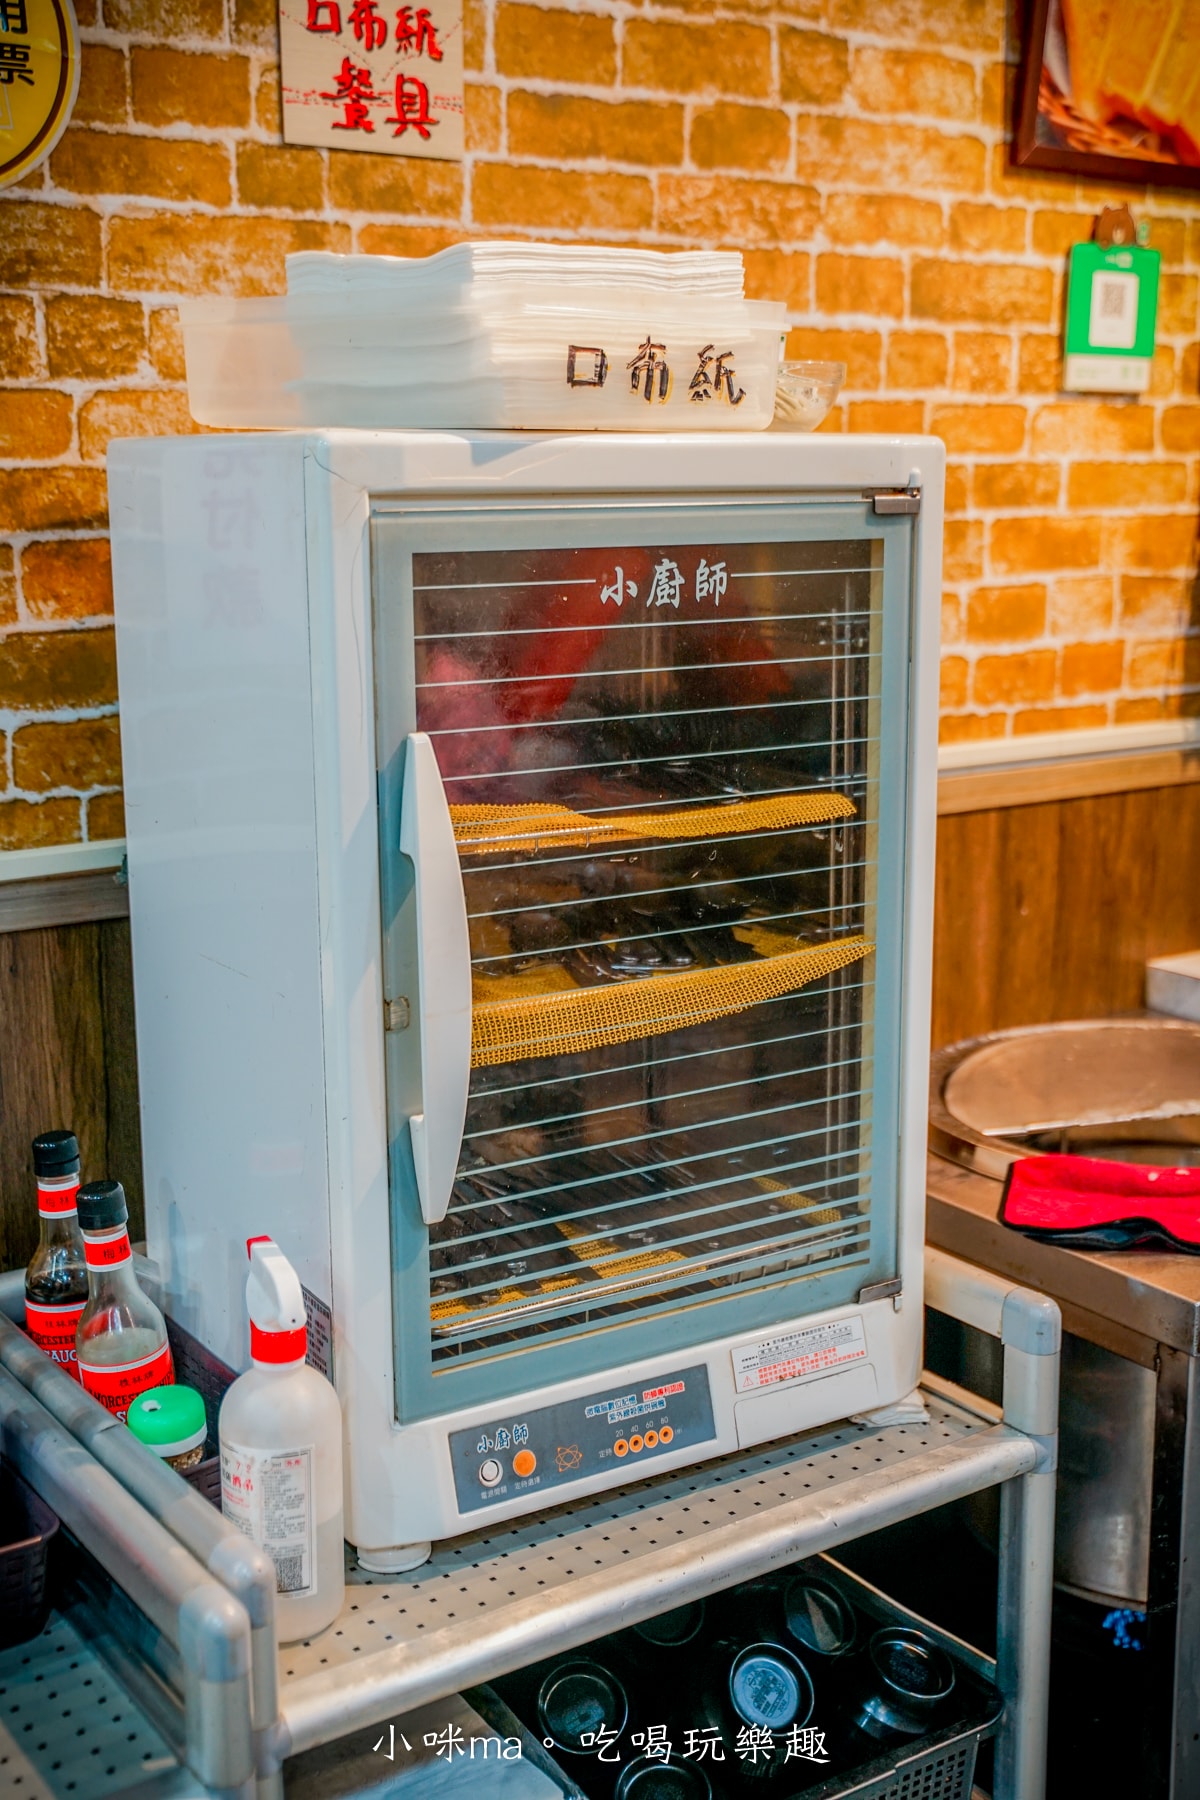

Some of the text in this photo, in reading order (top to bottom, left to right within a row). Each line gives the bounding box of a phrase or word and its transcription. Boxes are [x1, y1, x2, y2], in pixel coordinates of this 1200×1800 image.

[306, 0, 443, 61] 口布紙
[319, 57, 439, 140] 餐具
[567, 335, 746, 405] 口布紙
[600, 558, 728, 609] 小廚師
[477, 1423, 529, 1453] 小廚師
[615, 1416, 669, 1438] 20 40 60 80
